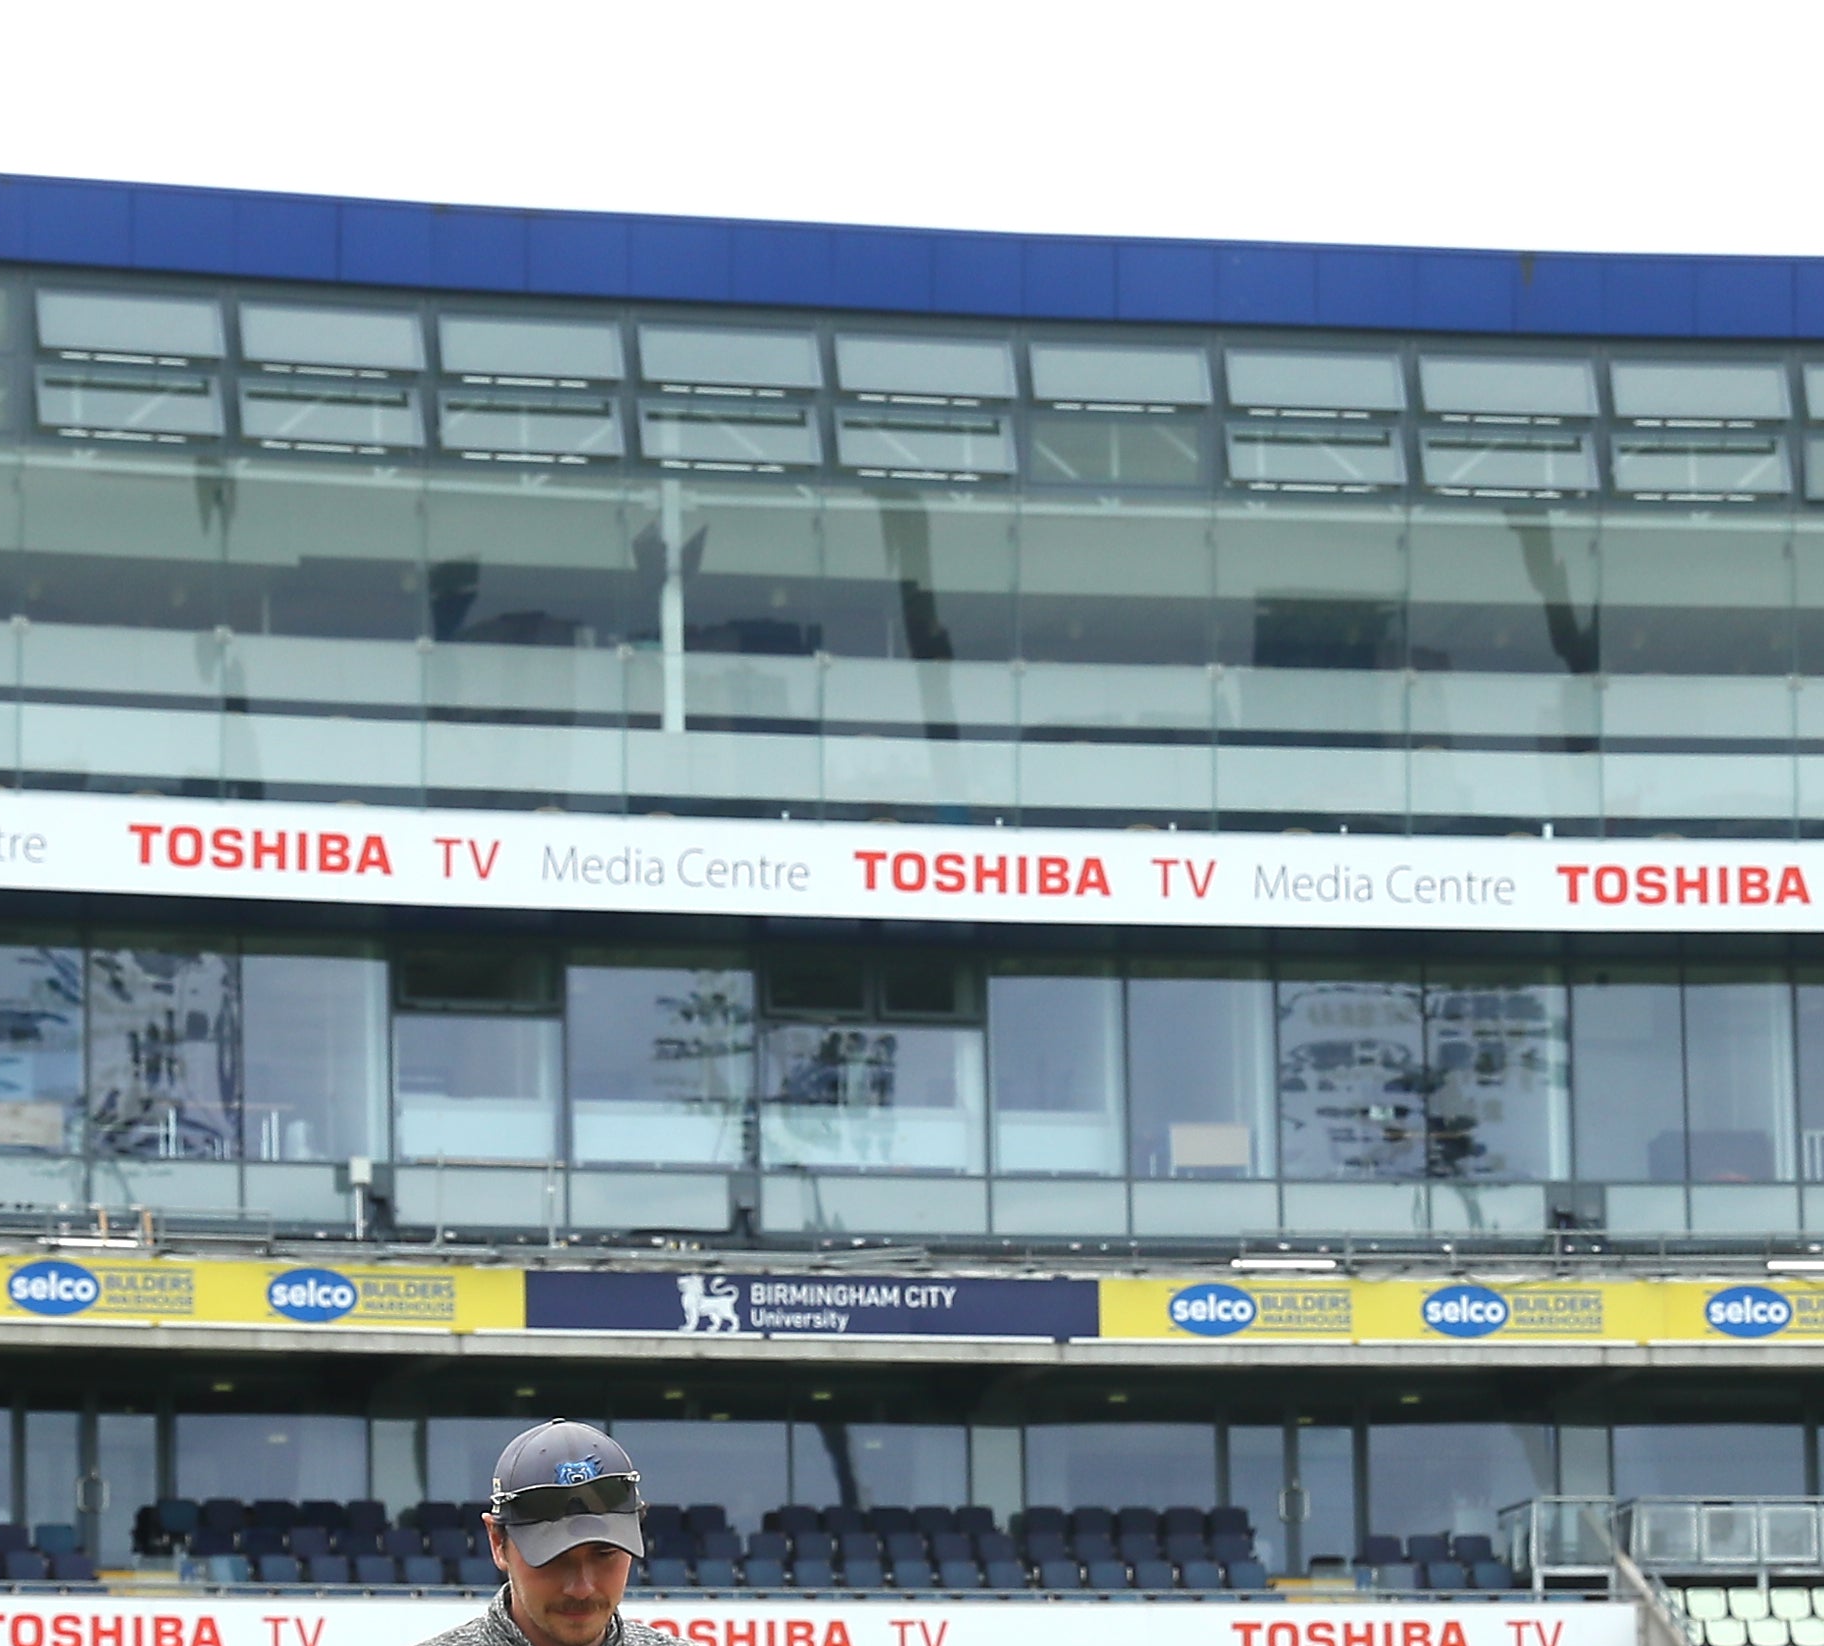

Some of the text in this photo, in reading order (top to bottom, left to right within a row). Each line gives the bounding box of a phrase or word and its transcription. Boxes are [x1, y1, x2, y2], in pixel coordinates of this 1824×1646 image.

[130, 825, 391, 875] TOSHIBA
[435, 837, 500, 880] TV
[542, 845, 664, 886] Media
[677, 848, 810, 891] Centre
[855, 851, 1110, 896] TOSHIBA
[1152, 858, 1216, 898] TV
[1254, 864, 1373, 902] Media
[1386, 865, 1515, 905] Centre
[1558, 866, 1810, 904] TOSHIBA
[9, 1272, 98, 1302] selco
[270, 1281, 353, 1310] selco
[750, 1283, 956, 1309] BIRMINGHAM CITY
[750, 1309, 849, 1332] University
[1172, 1295, 1253, 1322] selco
[1425, 1298, 1505, 1325] selco
[1709, 1300, 1787, 1325] selco
